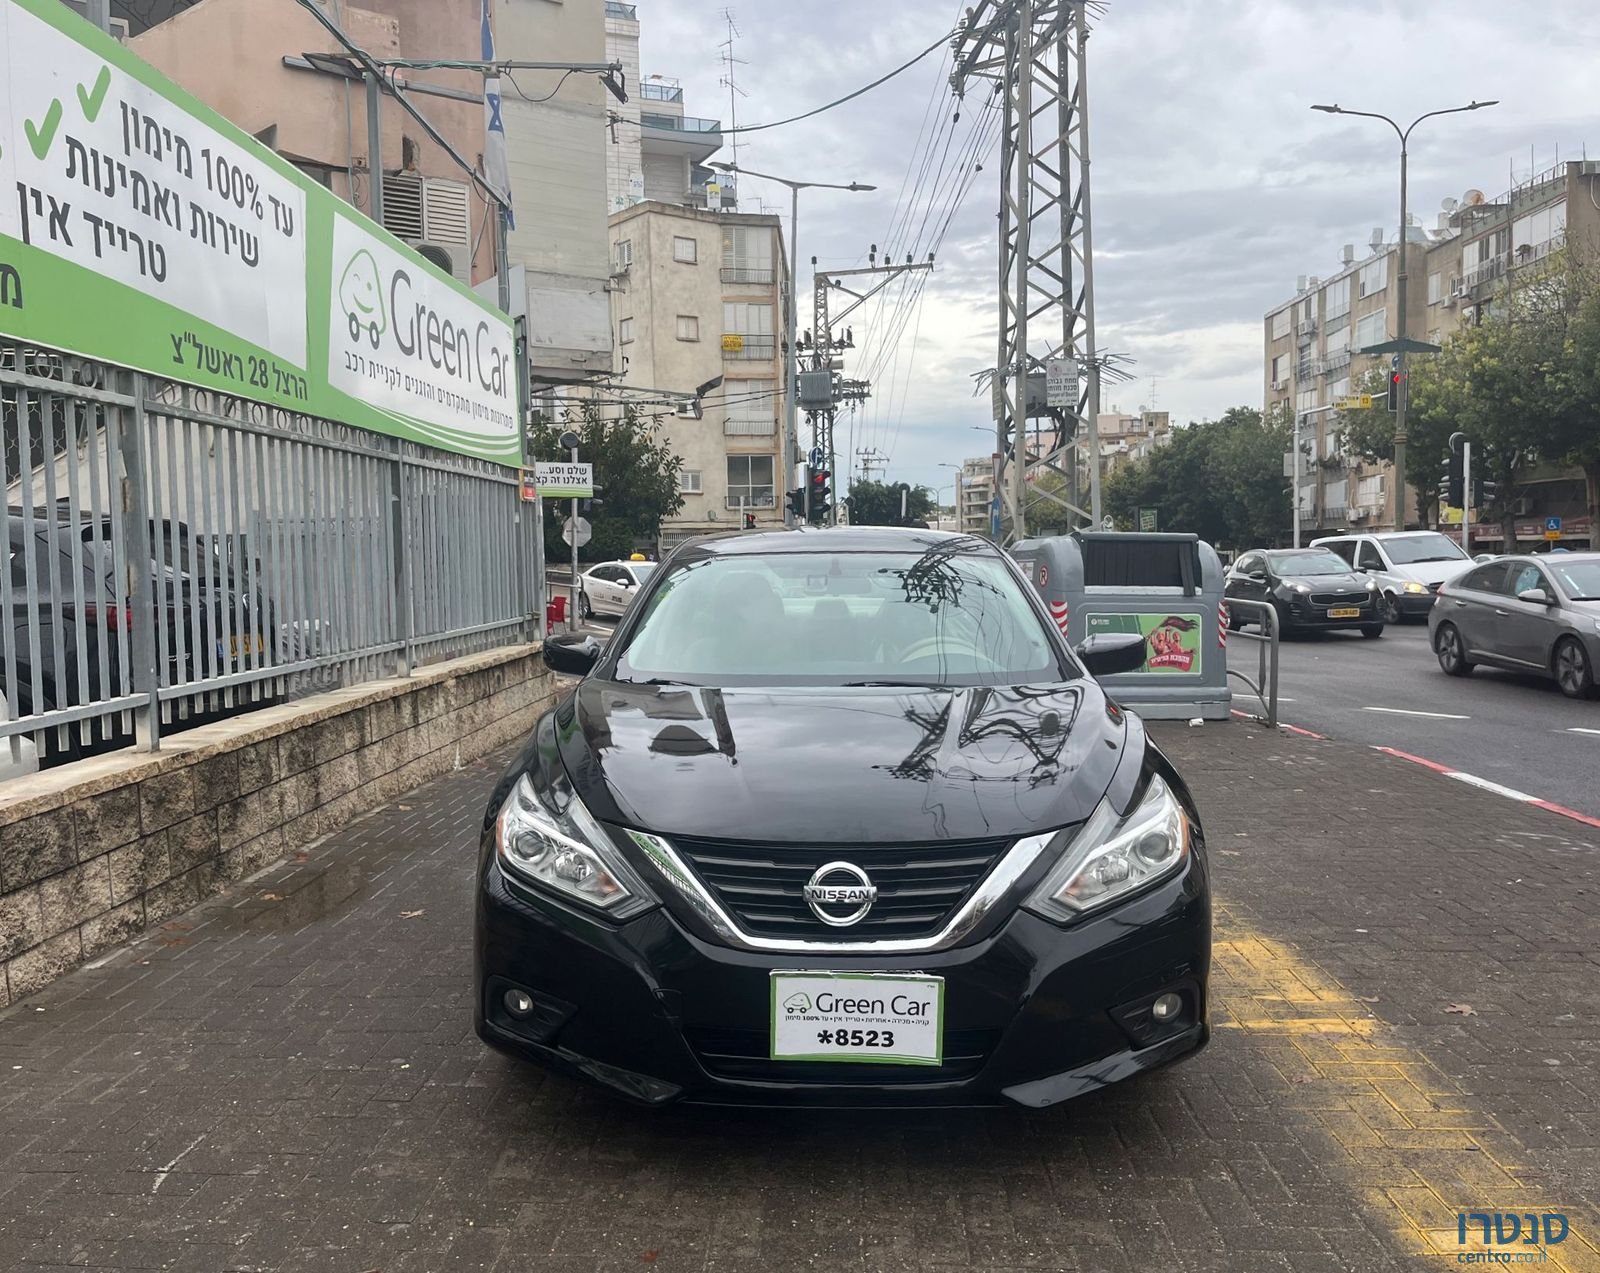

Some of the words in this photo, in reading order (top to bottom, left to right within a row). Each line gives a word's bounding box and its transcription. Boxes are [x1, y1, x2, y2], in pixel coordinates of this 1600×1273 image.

[120, 100, 193, 179] מימון
[65, 134, 182, 232] ואמינות
[201, 149, 264, 220] 100%
[16, 181, 74, 245] אין
[268, 194, 294, 238] עד
[83, 210, 167, 283] טרייד
[190, 201, 259, 267] שירות
[390, 269, 471, 383] Green
[476, 321, 509, 399] Car
[170, 331, 244, 382] ראשל"צ
[248, 355, 269, 389] 28
[345, 350, 365, 375] רכב
[272, 361, 308, 401] הרצל
[369, 359, 401, 391] לקניית
[405, 374, 435, 401] והוגנים
[437, 388, 471, 414] מתקדמים
[472, 401, 490, 420] מימון
[535, 476, 548, 486] קצ
[550, 476, 560, 484] זה
[563, 475, 588, 485] אצלנו
[567, 465, 587, 475] שלם
[811, 890, 869, 900] NISSAN
[816, 992, 884, 1014] Green
[891, 995, 931, 1016] Car
